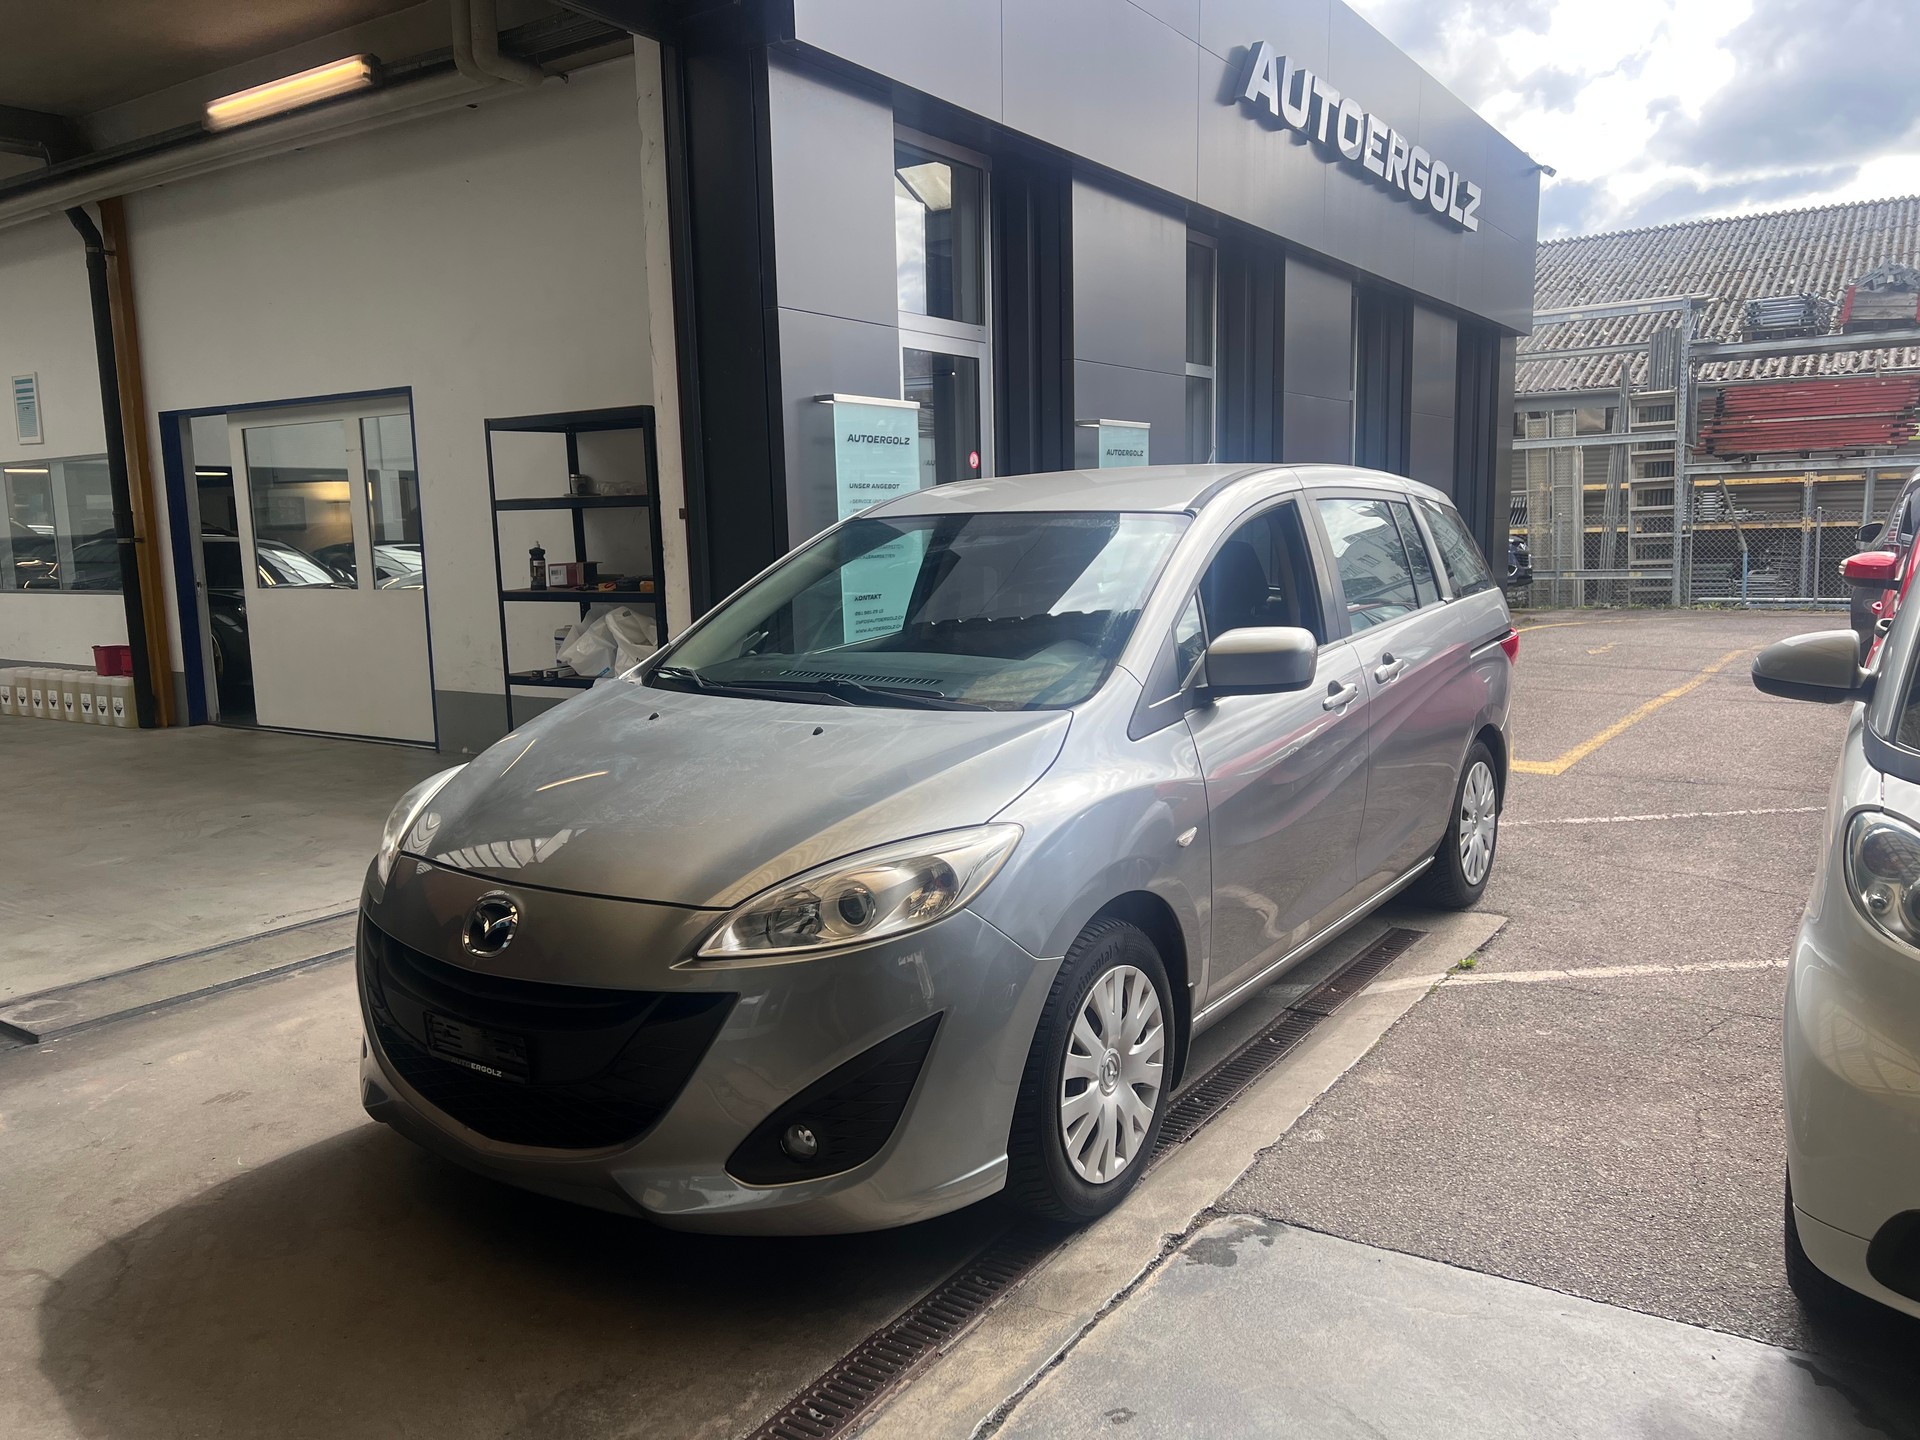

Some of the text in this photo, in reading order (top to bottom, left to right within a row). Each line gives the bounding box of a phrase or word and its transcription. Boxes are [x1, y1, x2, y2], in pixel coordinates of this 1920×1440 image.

[1240, 40, 1482, 232] AUTOERGOLZ
[847, 434, 910, 445] AUTOERGOLZ
[1106, 448, 1144, 457] AUTOERGOLZ
[450, 1057, 502, 1077] AUTOERGOLZ
